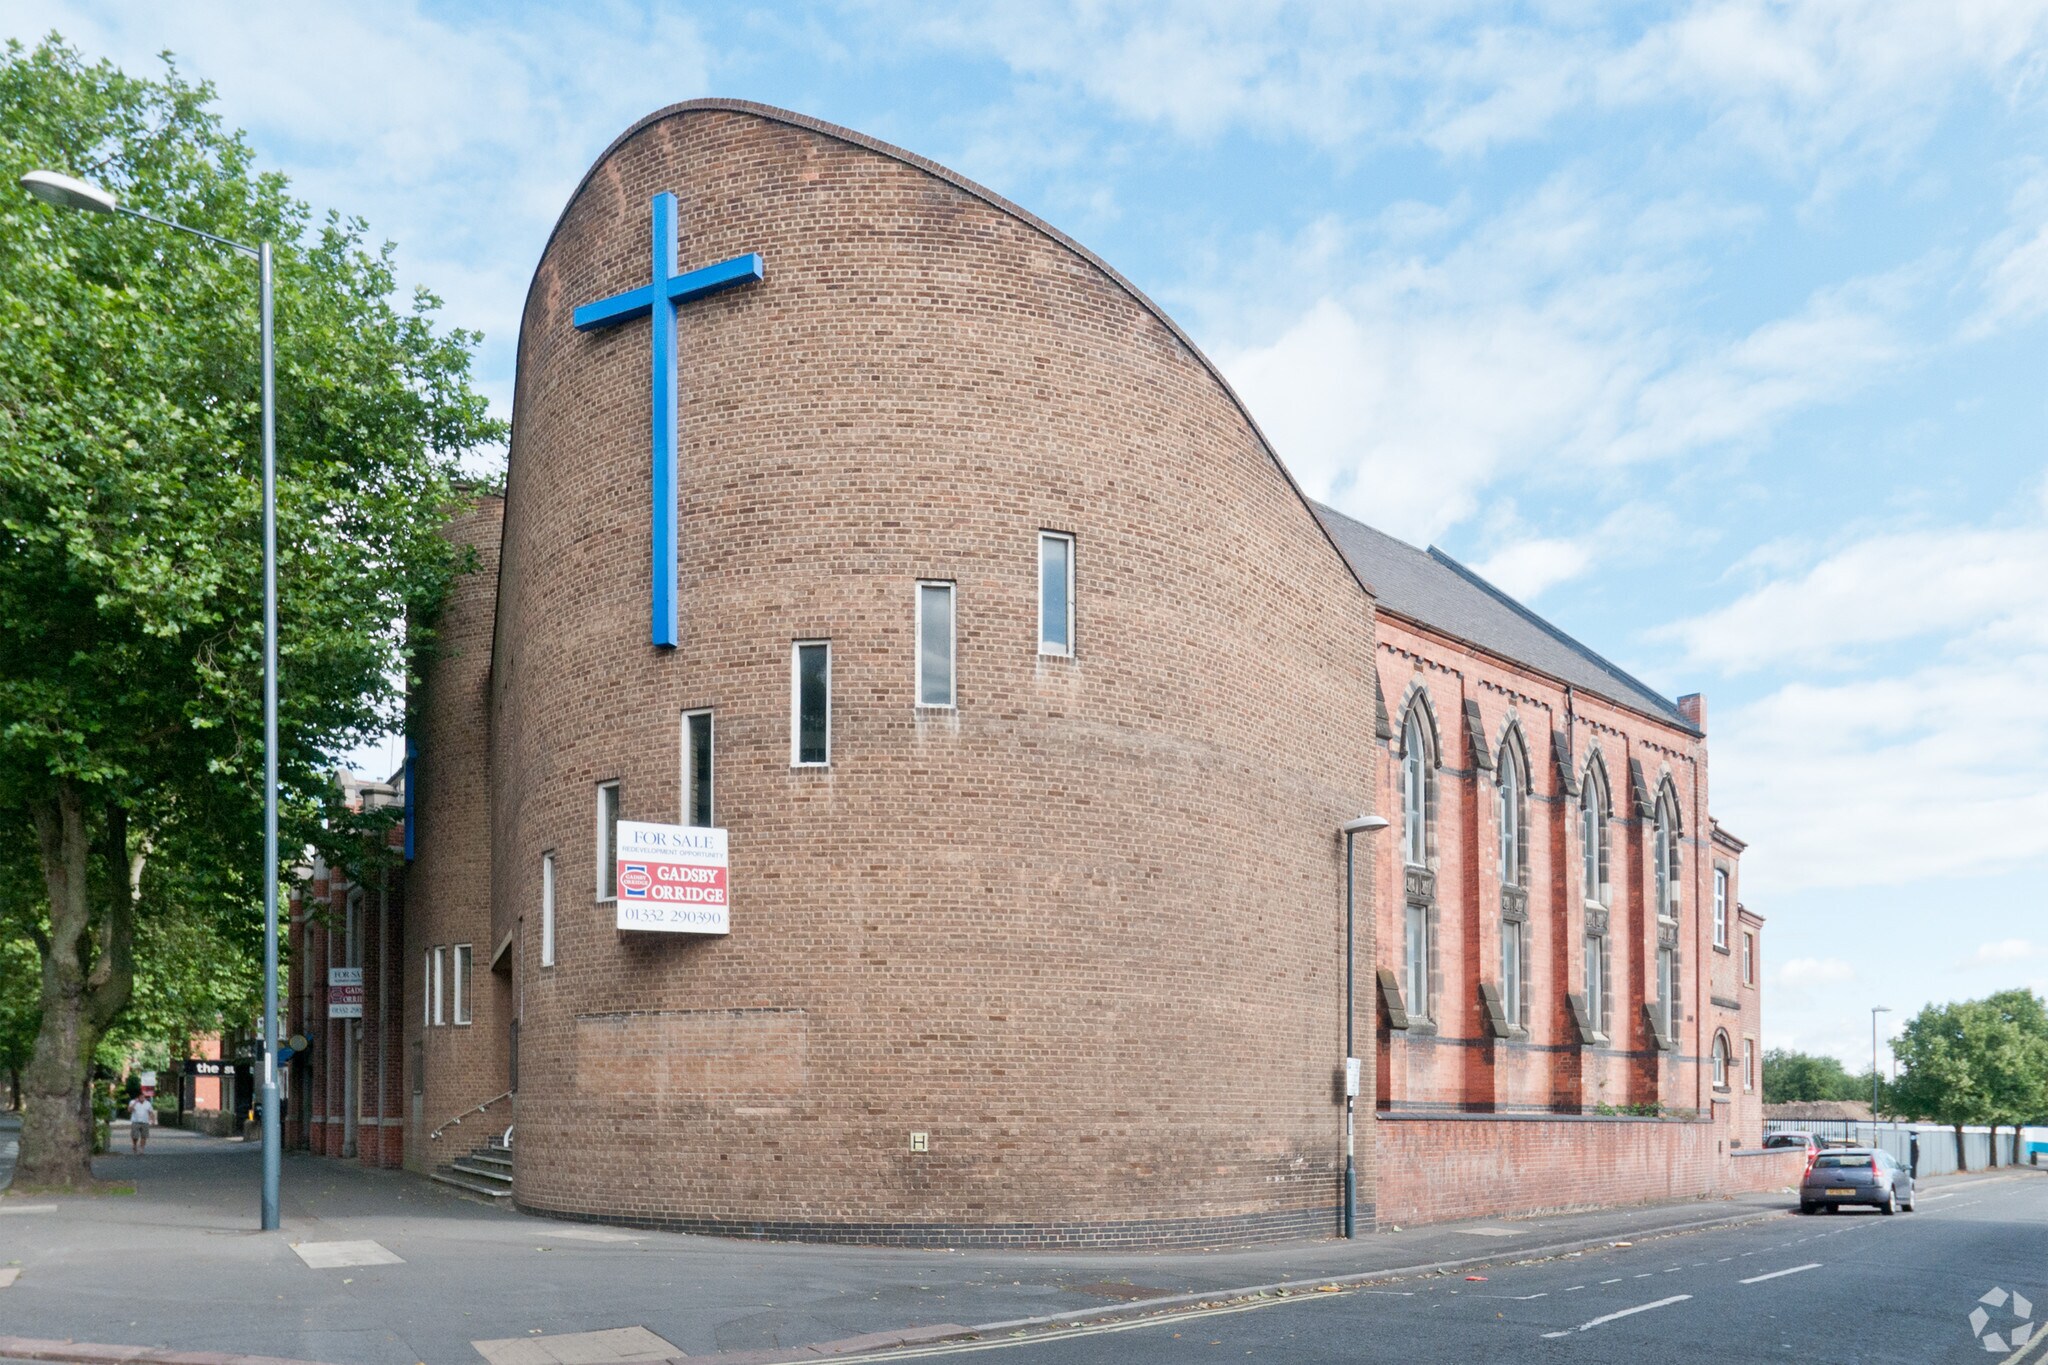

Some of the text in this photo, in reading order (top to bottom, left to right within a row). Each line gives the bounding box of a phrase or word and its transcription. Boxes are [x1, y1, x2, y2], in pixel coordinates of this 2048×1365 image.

[635, 831, 714, 849] FOR SALE
[622, 846, 724, 858] REDEVELOPMENT OPPORTUNITY
[657, 866, 718, 883] GADSBY
[651, 885, 724, 903] ORRIDGE
[625, 908, 721, 925] 01332 290390
[196, 1062, 219, 1074] the
[913, 1135, 927, 1150] H
